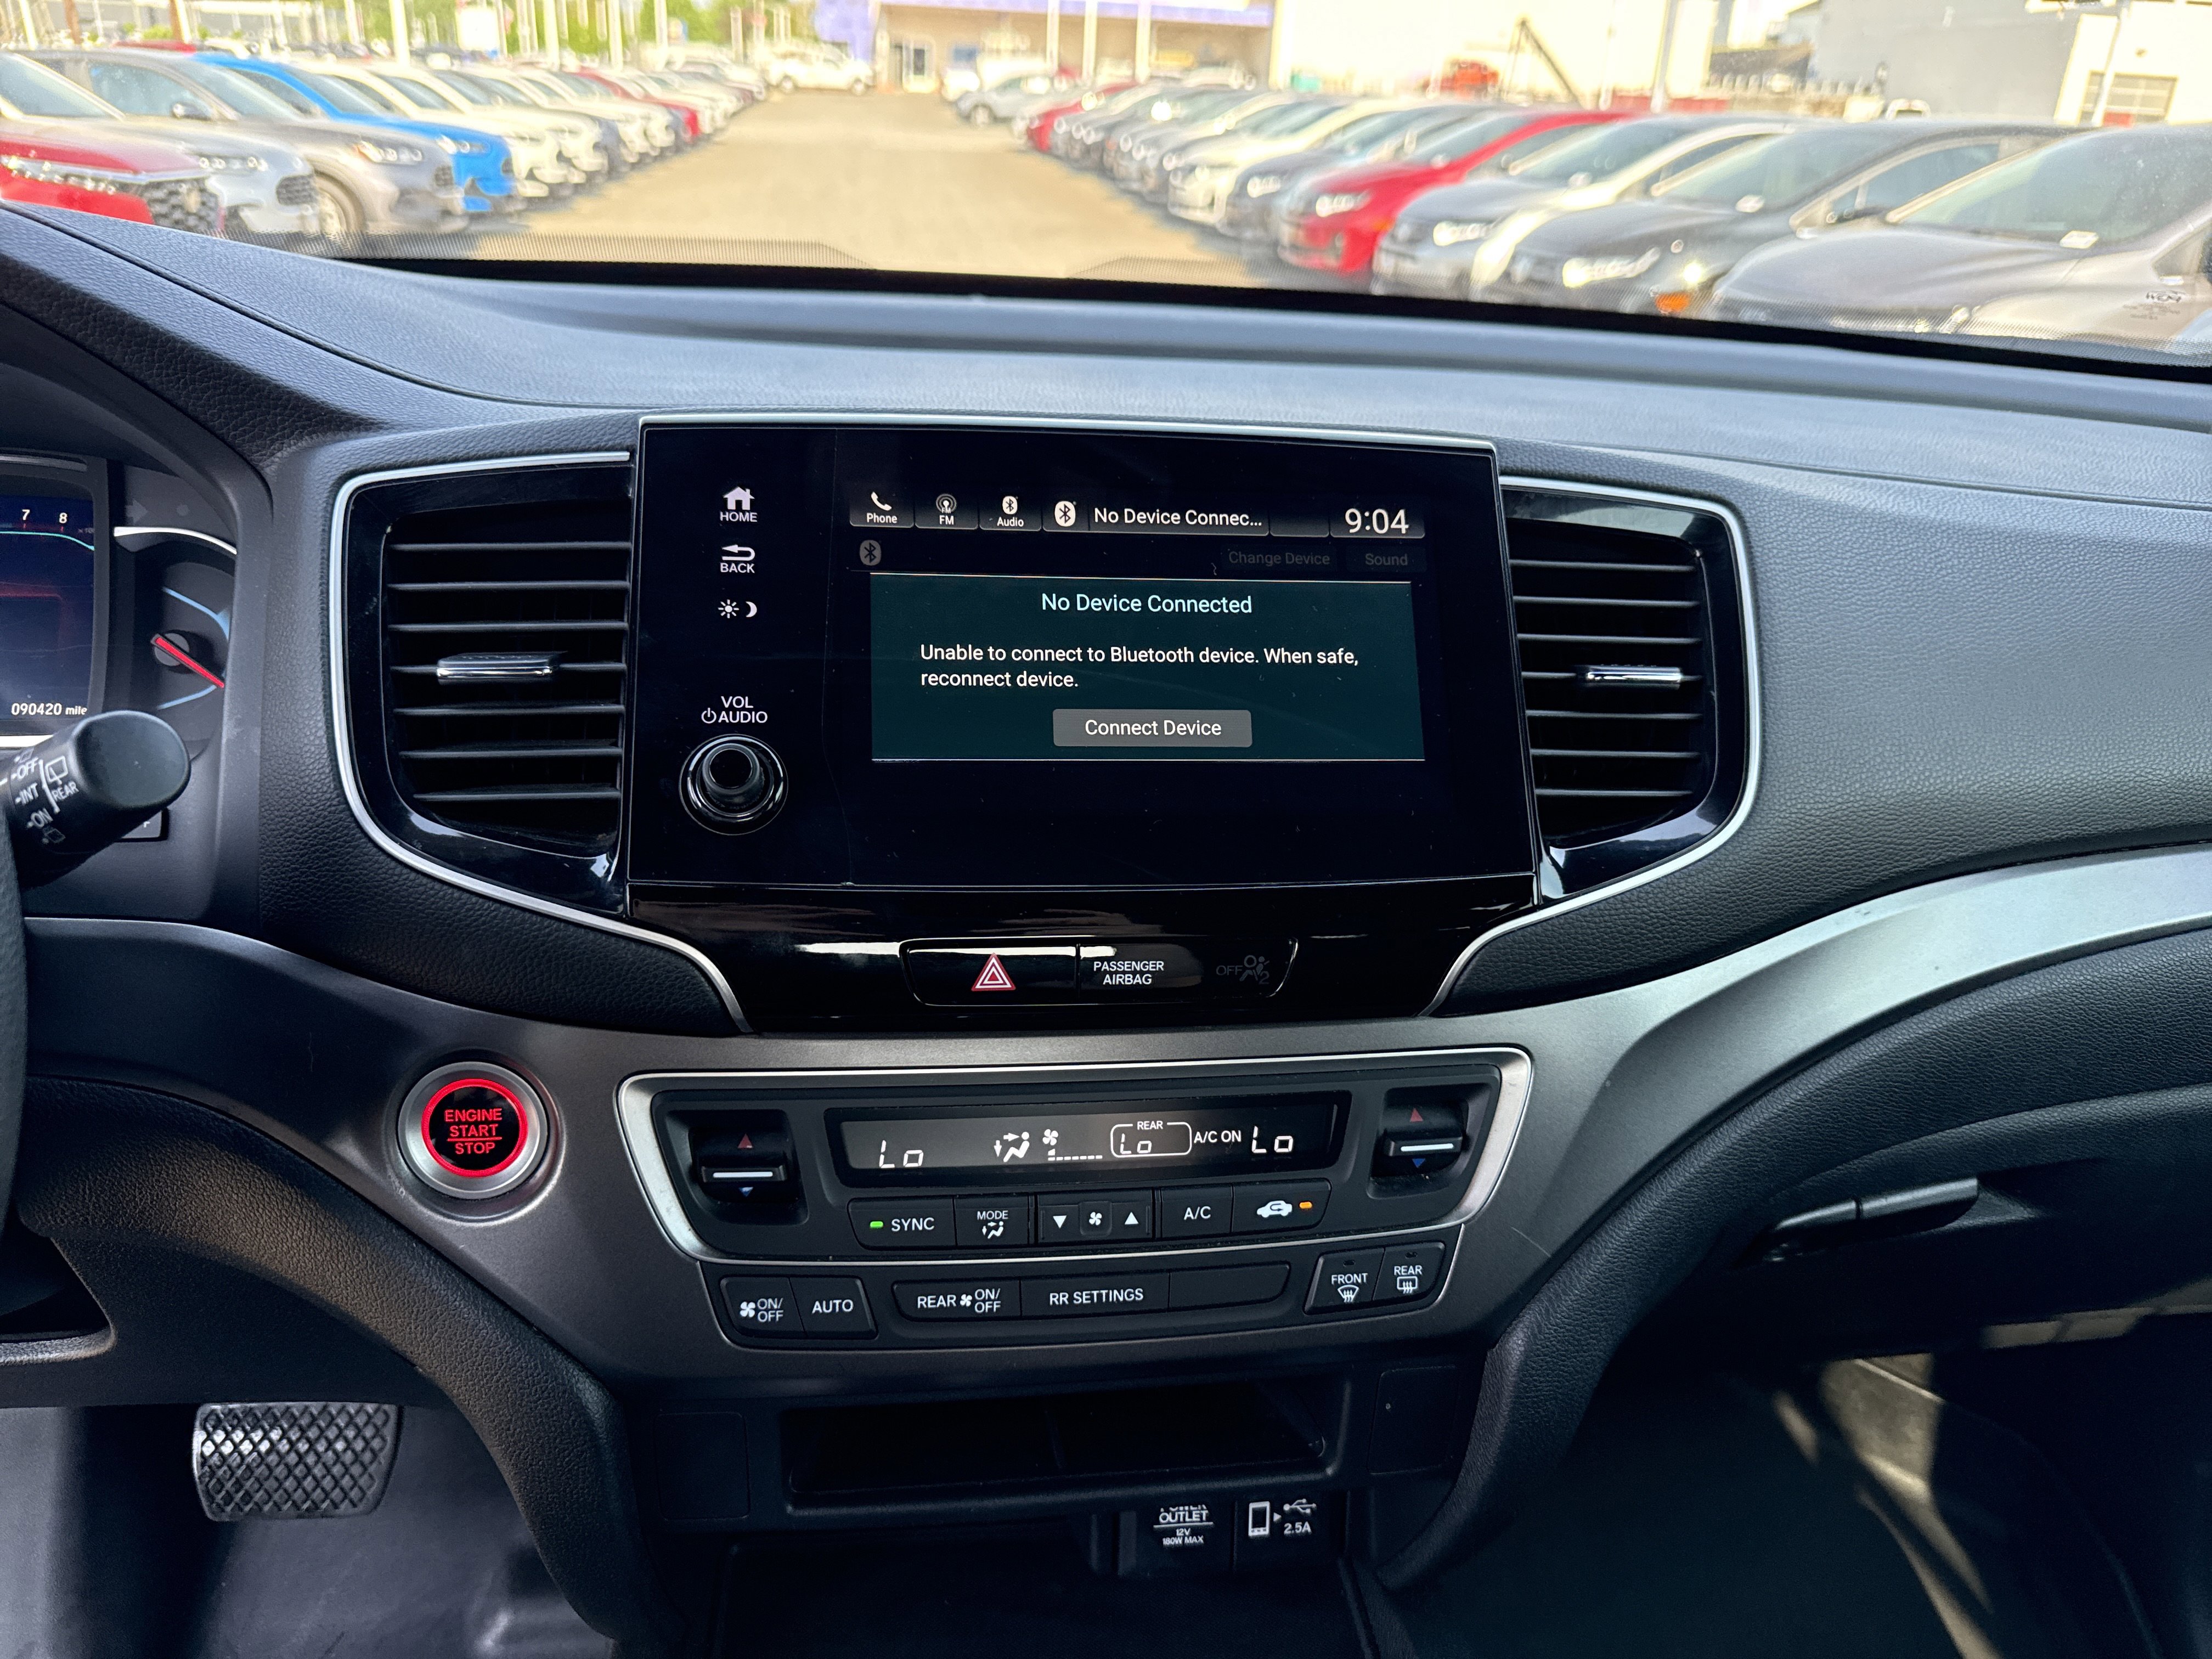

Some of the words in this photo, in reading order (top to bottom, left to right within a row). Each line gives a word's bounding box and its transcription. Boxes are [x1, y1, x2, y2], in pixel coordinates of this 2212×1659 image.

[22, 509, 30, 521] 7
[59, 512, 67, 524] 8
[720, 511, 758, 522] HOME
[866, 512, 898, 524] Phone
[939, 515, 954, 525] FM
[997, 516, 1024, 527] Audio
[1094, 507, 1119, 523] No
[1124, 508, 1181, 524] Device
[1185, 510, 1262, 526] Connec...
[1345, 508, 1409, 534] 9:04
[1228, 551, 1282, 567] Change
[1285, 552, 1330, 565] Device
[1365, 553, 1408, 566] Sound
[720, 562, 755, 573] BACK
[1042, 593, 1070, 611] No
[1076, 594, 1142, 612] Device
[1148, 595, 1252, 613] Connected
[921, 644, 984, 661] Unable
[987, 646, 1006, 661] to
[1011, 647, 1083, 662] connect
[1086, 647, 1105, 662] to
[1110, 646, 1194, 663] Bluetooth
[1199, 647, 1259, 663] device.
[1263, 647, 1312, 664] When
[1317, 647, 1358, 666] safe,
[921, 672, 1012, 687] reconnect
[1016, 670, 1078, 687] device.
[720, 696, 754, 708] VOL
[11, 703, 62, 715] 090420
[65, 706, 88, 715] mile
[718, 710, 768, 724] AUDIO
[1085, 719, 1159, 736] Connect
[1164, 720, 1222, 736] Device
[17, 757, 40, 780] OFF
[20, 782, 39, 805] INT
[52, 781, 79, 801] REAR
[30, 807, 54, 828] ON
[1093, 961, 1164, 972] PASSENGER
[1216, 965, 1243, 977] OFF
[1103, 973, 1152, 985] AIRBAG
[444, 1108, 503, 1122] ENGINE
[449, 1124, 499, 1137] START
[1137, 1120, 1164, 1130] REAR
[1193, 1131, 1218, 1144] A/C
[1221, 1130, 1242, 1143] ON
[455, 1142, 495, 1155] STOP
[977, 1210, 1008, 1220] MODE
[1183, 1206, 1211, 1220] A/C
[891, 1217, 935, 1232] SYNC
[1393, 1265, 1423, 1276] REAR
[1331, 1273, 1368, 1286] FRONT
[974, 1288, 1001, 1300] ON/
[1049, 1292, 1069, 1305] RR
[1073, 1288, 1144, 1304] SETTINGS
[757, 1298, 783, 1310] ON/
[811, 1299, 854, 1313] AUTO
[917, 1294, 957, 1308] REAR
[974, 1301, 1001, 1313] OFF
[757, 1310, 784, 1322] OFF
[1159, 1510, 1209, 1523] OUTLET
[1176, 1528, 1191, 1536] 12V
[1284, 1521, 1312, 1535] 2.5A
[1184, 1535, 1204, 1544] MAX
